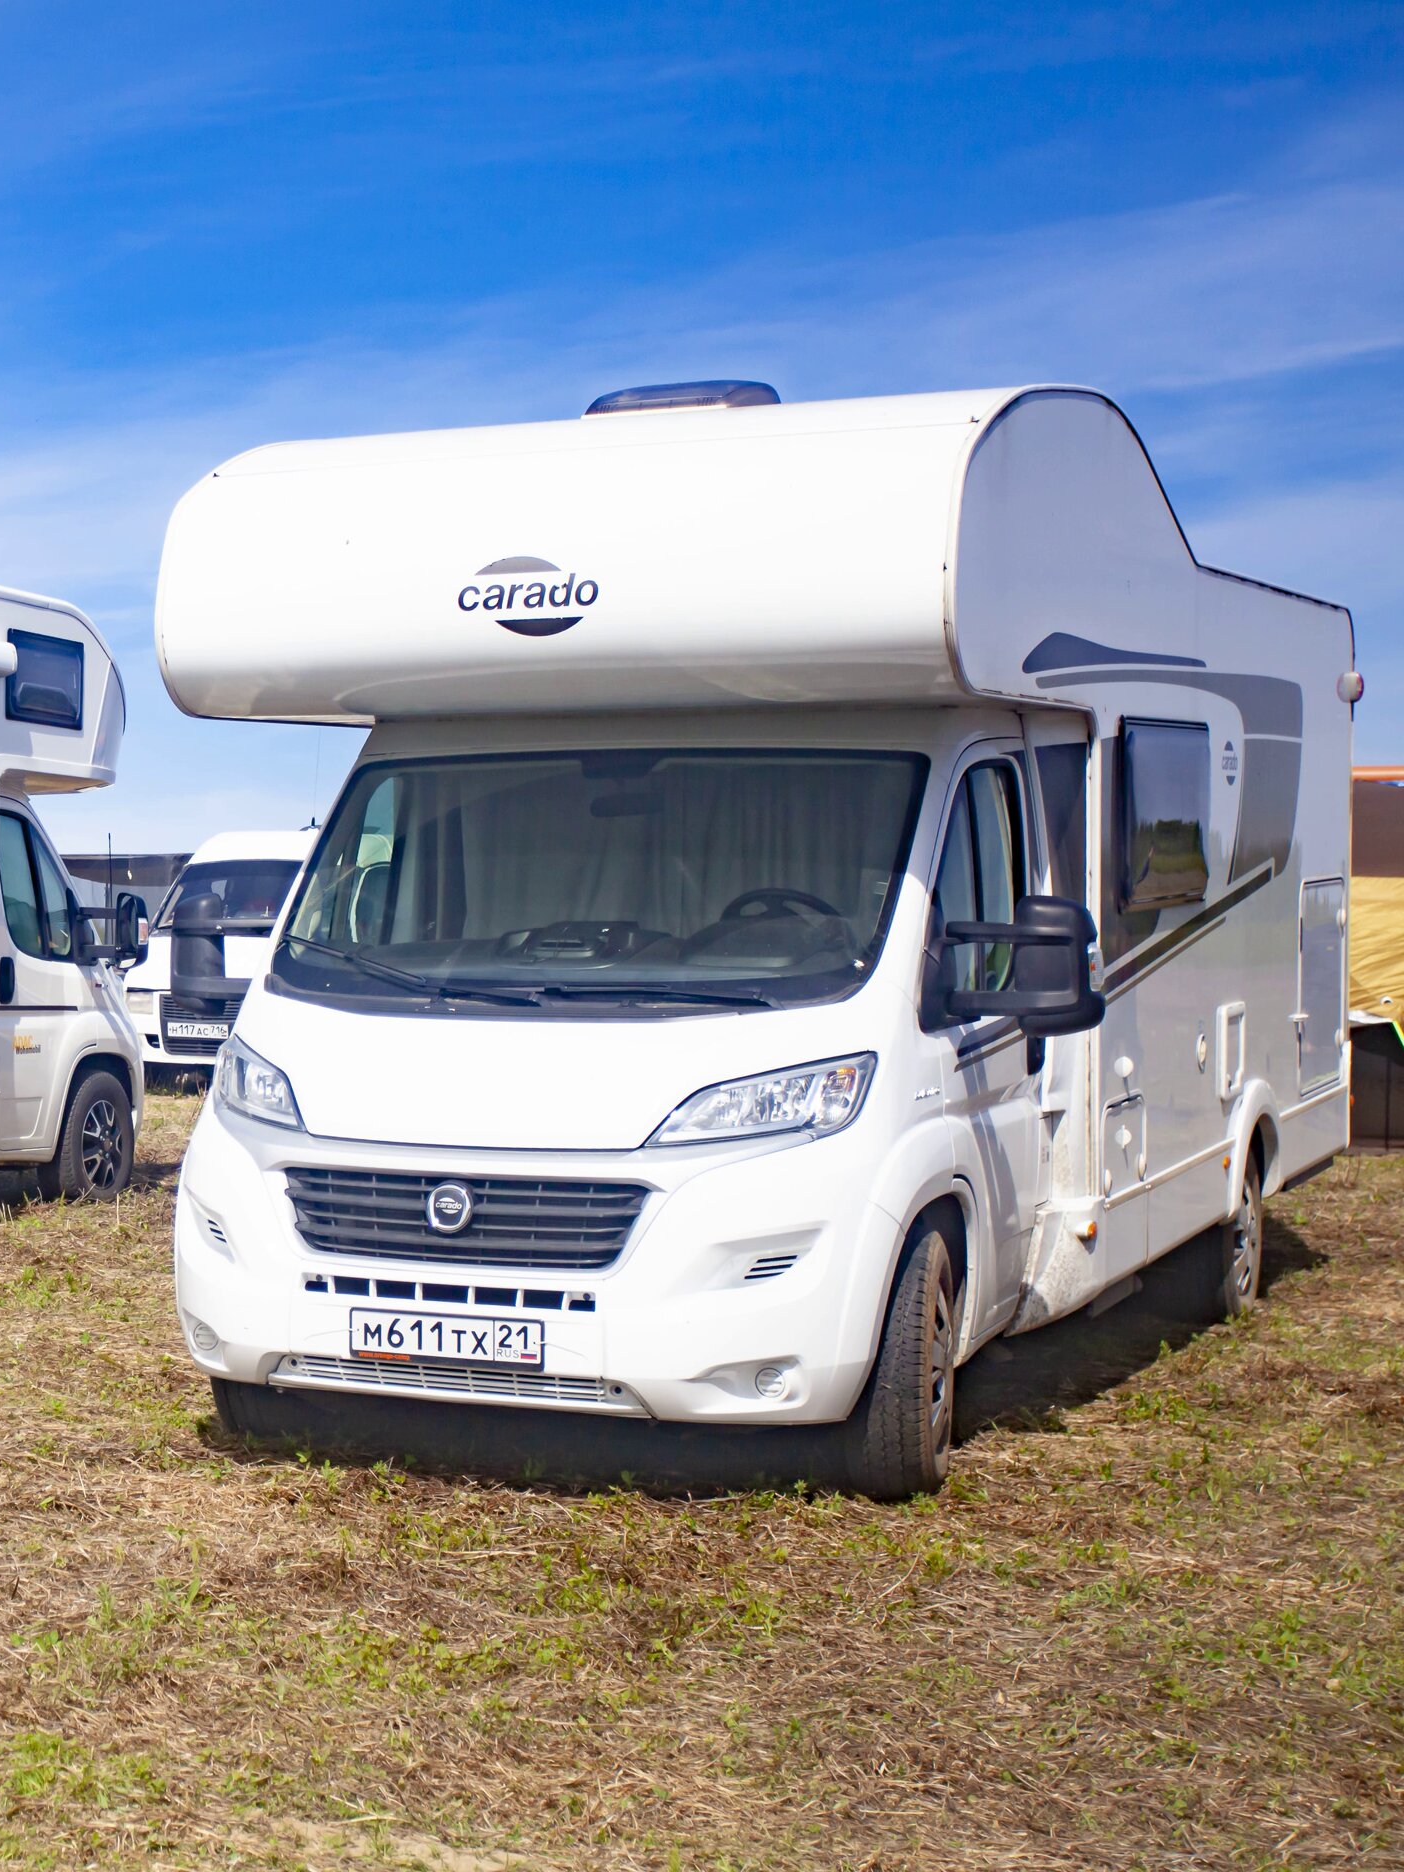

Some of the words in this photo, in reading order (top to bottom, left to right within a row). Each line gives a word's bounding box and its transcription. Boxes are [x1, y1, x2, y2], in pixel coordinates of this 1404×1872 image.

[457, 572, 600, 612] carado
[435, 1201, 463, 1210] carado
[498, 1324, 528, 1350] 21
[496, 1349, 520, 1359] RUS
